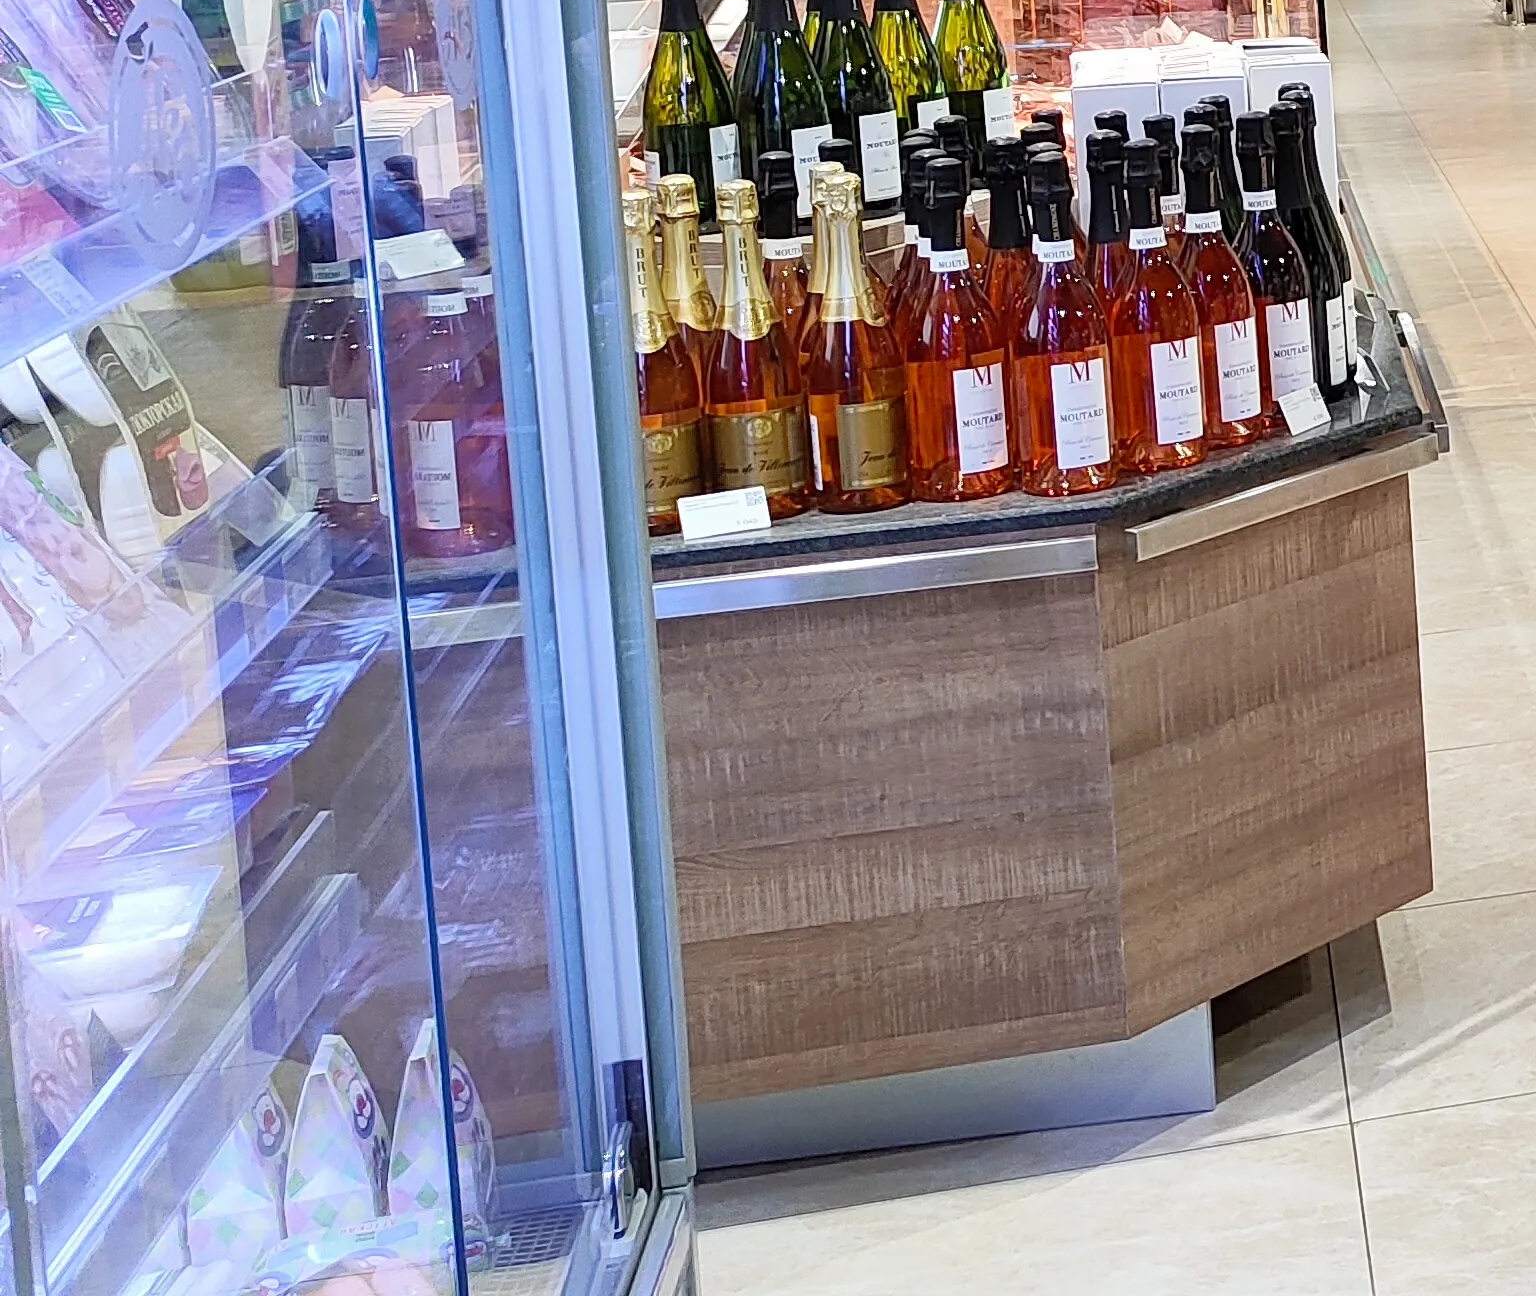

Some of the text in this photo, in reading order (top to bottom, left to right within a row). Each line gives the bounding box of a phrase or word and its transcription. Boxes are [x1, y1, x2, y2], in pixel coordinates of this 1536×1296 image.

[1162, 203, 1183, 212] OUTA
[688, 229, 701, 280] BRUT
[739, 237, 749, 287] BRUT
[636, 248, 647, 299] BRUT
[1281, 302, 1300, 322] M
[1230, 323, 1248, 342] M
[1168, 341, 1187, 361] M
[1273, 344, 1309, 358] MOUTARD
[971, 368, 992, 388] M
[1068, 363, 1092, 384] M
[1223, 364, 1256, 379] MOUTARD
[1159, 385, 1198, 400] MOUTARD
[962, 412, 1003, 428] MOUTARD
[1060, 408, 1103, 423] MOUTARD
